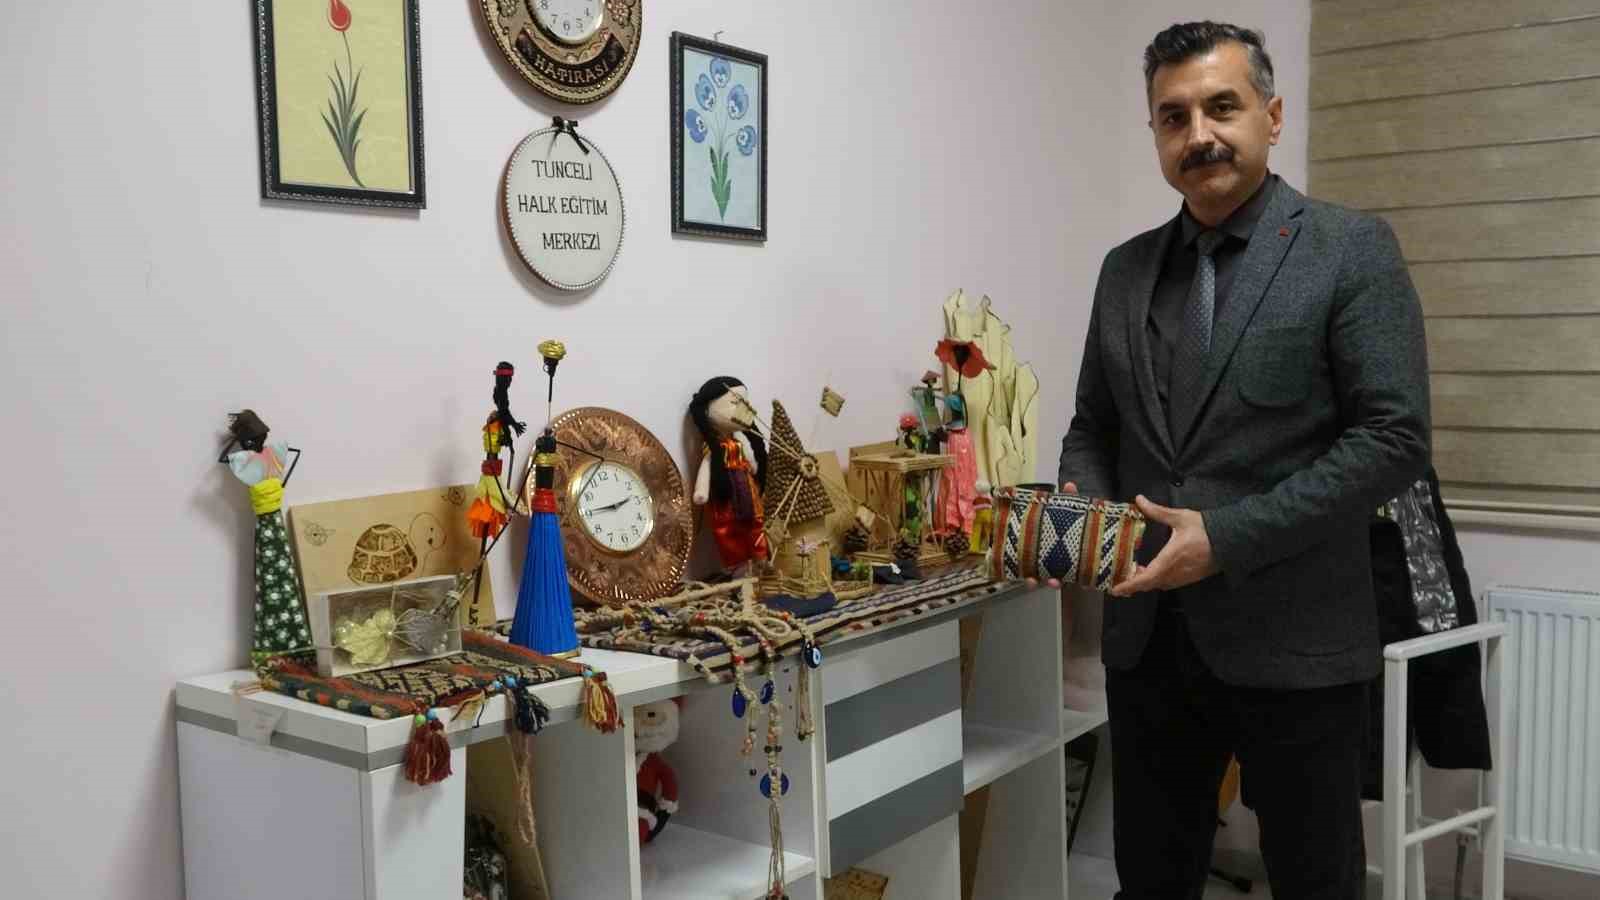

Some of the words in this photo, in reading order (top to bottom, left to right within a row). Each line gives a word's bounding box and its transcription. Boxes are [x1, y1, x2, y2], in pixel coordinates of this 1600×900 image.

[562, 20, 571, 32] 6
[517, 194, 558, 214] HALK
[560, 195, 608, 216] EĞİTİM
